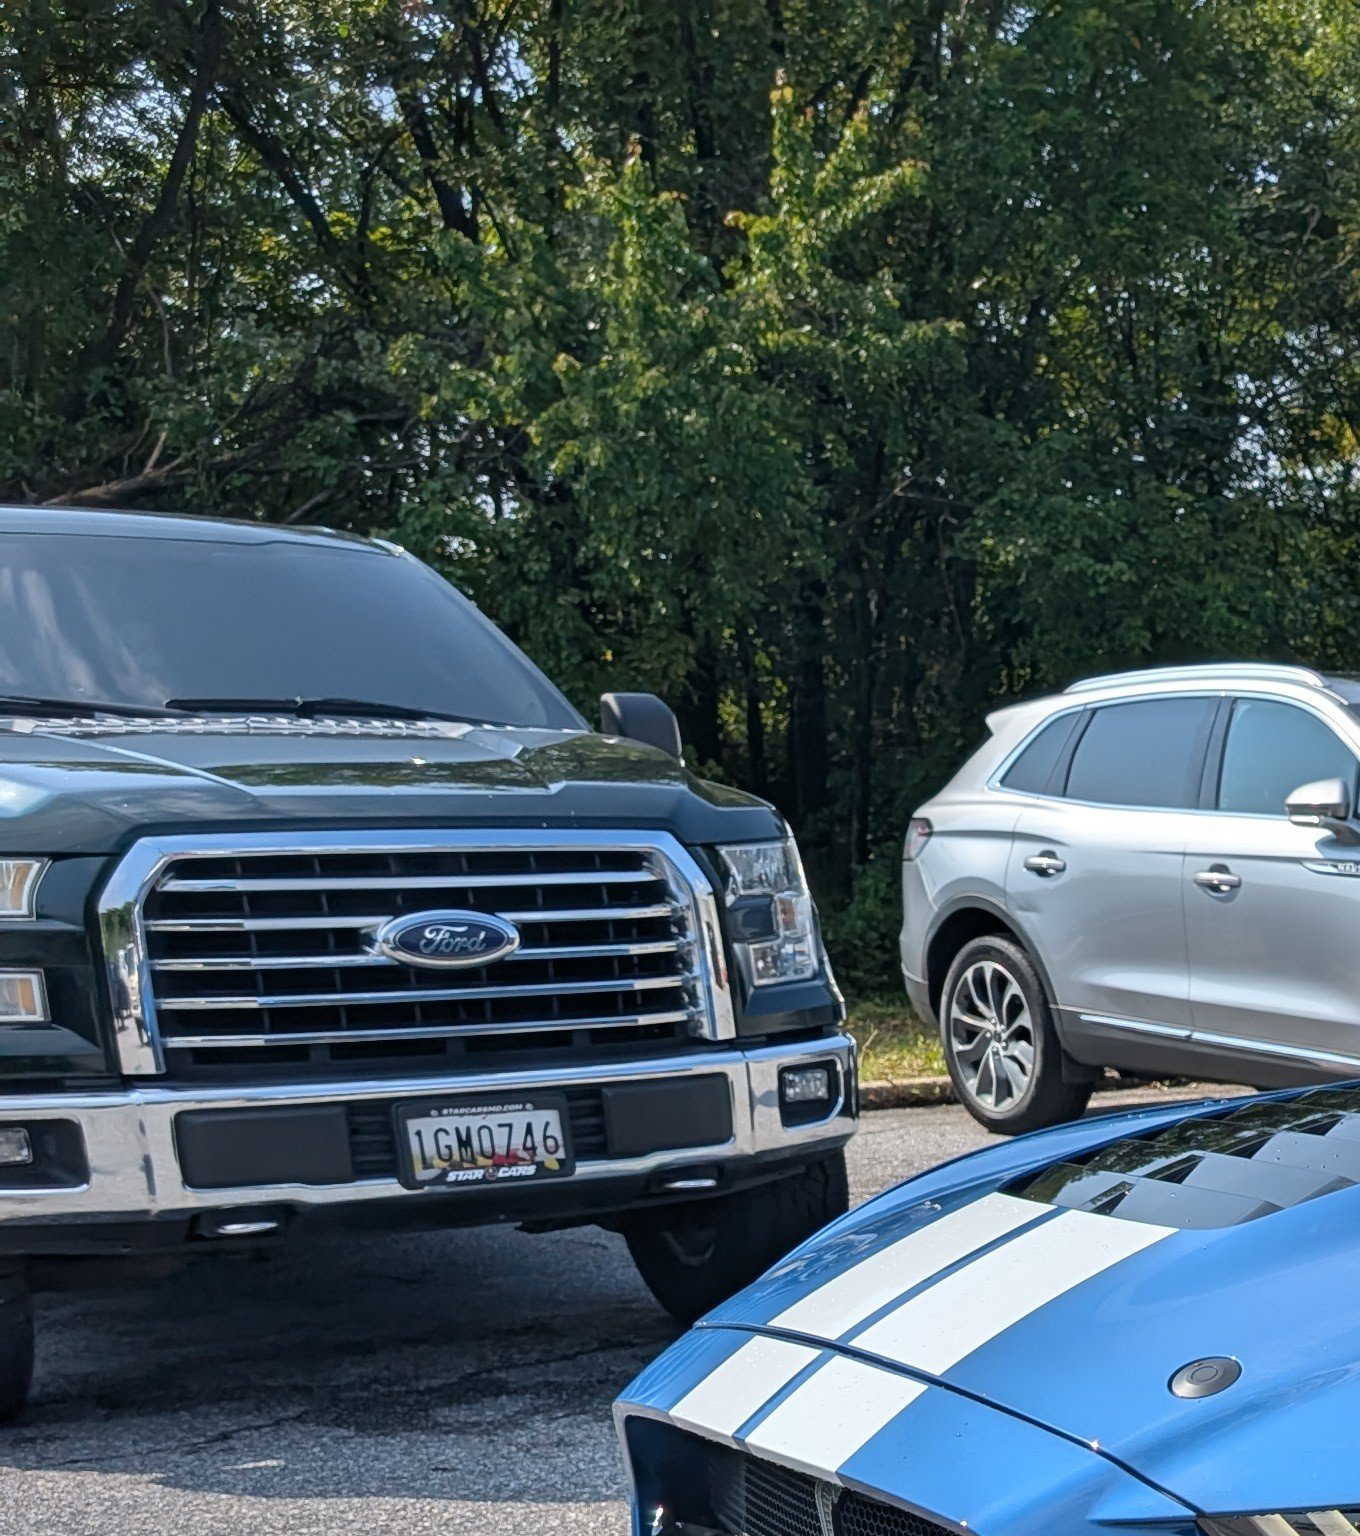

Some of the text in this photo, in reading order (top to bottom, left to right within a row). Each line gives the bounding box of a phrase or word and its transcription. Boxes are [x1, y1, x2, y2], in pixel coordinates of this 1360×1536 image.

[419, 925, 486, 954] Ford
[414, 1121, 560, 1170] 1GM0746
[446, 1164, 537, 1182] STAR CARS
